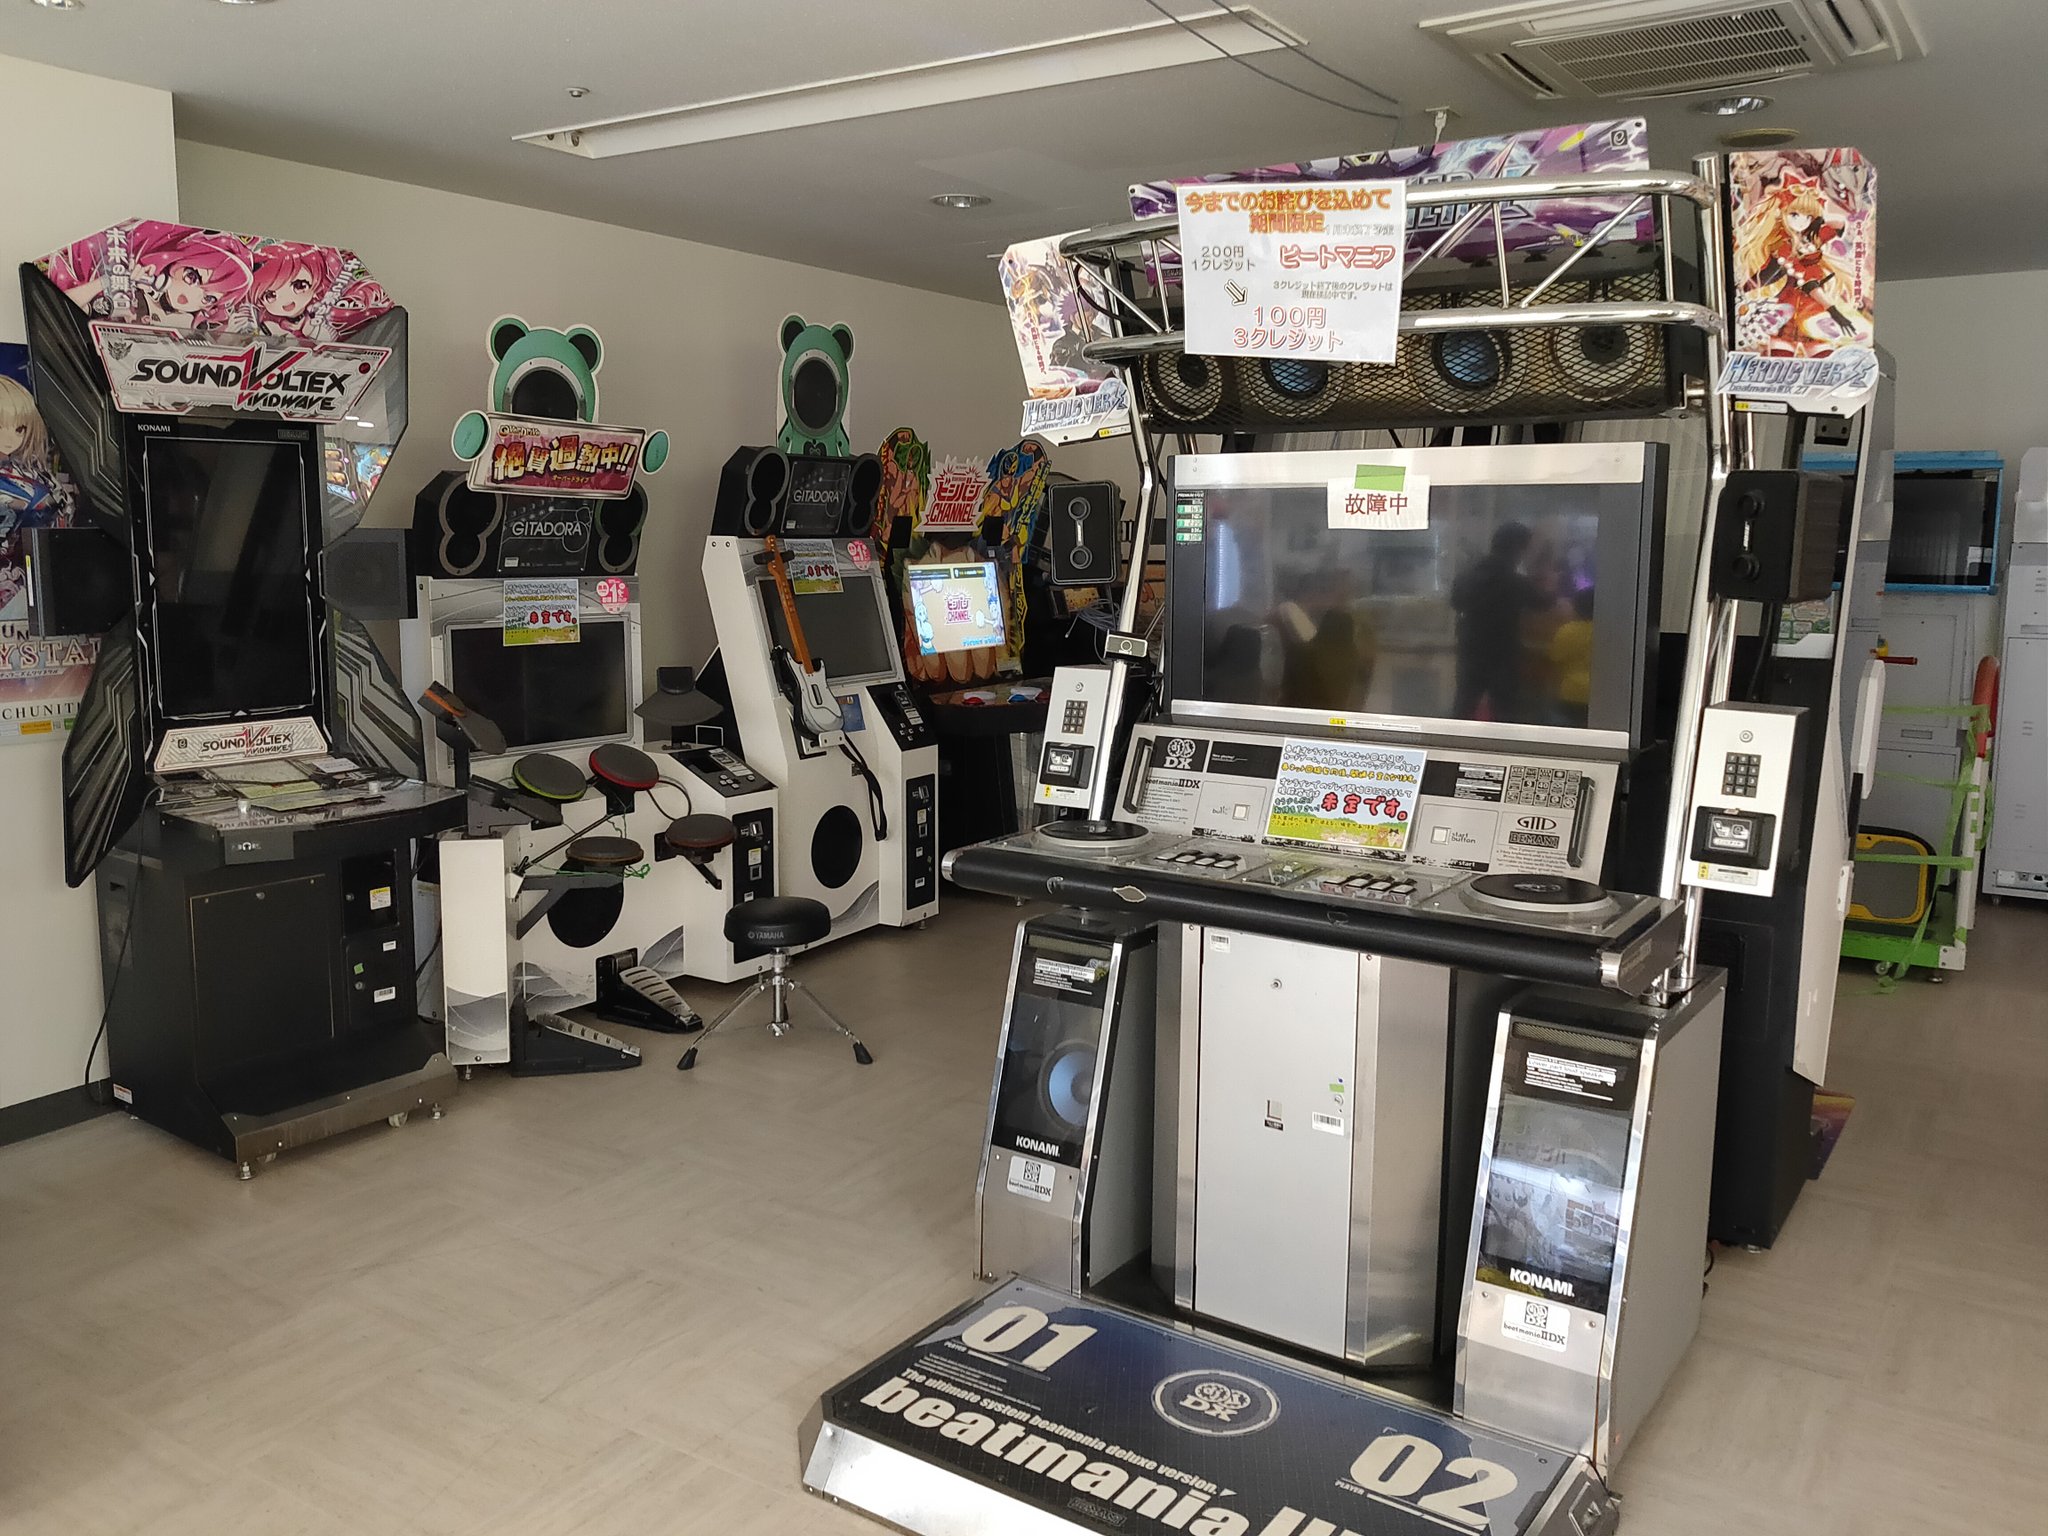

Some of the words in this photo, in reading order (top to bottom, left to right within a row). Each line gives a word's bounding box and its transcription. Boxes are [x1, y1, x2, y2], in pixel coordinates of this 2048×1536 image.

[1185, 189, 1393, 212] 今までのお詫びを込めて
[1249, 213, 1325, 235] 期間限定
[1201, 246, 1245, 258] 200円
[1280, 244, 1396, 269] ビートマニア
[1192, 259, 1256, 272] 1クレジット
[1253, 306, 1327, 329] 100円
[1233, 328, 1344, 352] 3クレジット
[129, 359, 242, 389] SOUND
[1716, 354, 1803, 391] HEROIC
[1794, 385, 1810, 394] 27
[137, 424, 171, 433] KONAMI
[794, 490, 840, 503] GITADORA
[936, 477, 983, 501] ビシバシ
[930, 503, 974, 522] CHANNEL
[1345, 494, 1408, 515] 故障中
[512, 521, 582, 536] GITADORA
[2, 702, 80, 720] CHUNIT
[202, 737, 245, 752] SOUND
[1164, 756, 1193, 769] DX
[1321, 792, 1408, 821] 未定です。
[1451, 836, 1476, 844] button
[1510, 833, 1558, 848] BEMANI
[755, 931, 785, 939] YAMAHA
[1016, 1135, 1060, 1157] KONAMI
[1510, 1268, 1575, 1298] KONAMI
[961, 1306, 1098, 1372] 01
[901, 1368, 925, 1383] The
[925, 1375, 981, 1404] ultimate
[980, 1397, 1032, 1422] system
[1029, 1414, 1106, 1450] beatmania
[1105, 1441, 1155, 1471] deluxe
[1156, 1460, 1218, 1495] version.
[860, 1376, 1250, 1536] beatmania
[1335, 1479, 1364, 1495] PLAYER
[1350, 1434, 1519, 1526] 02
